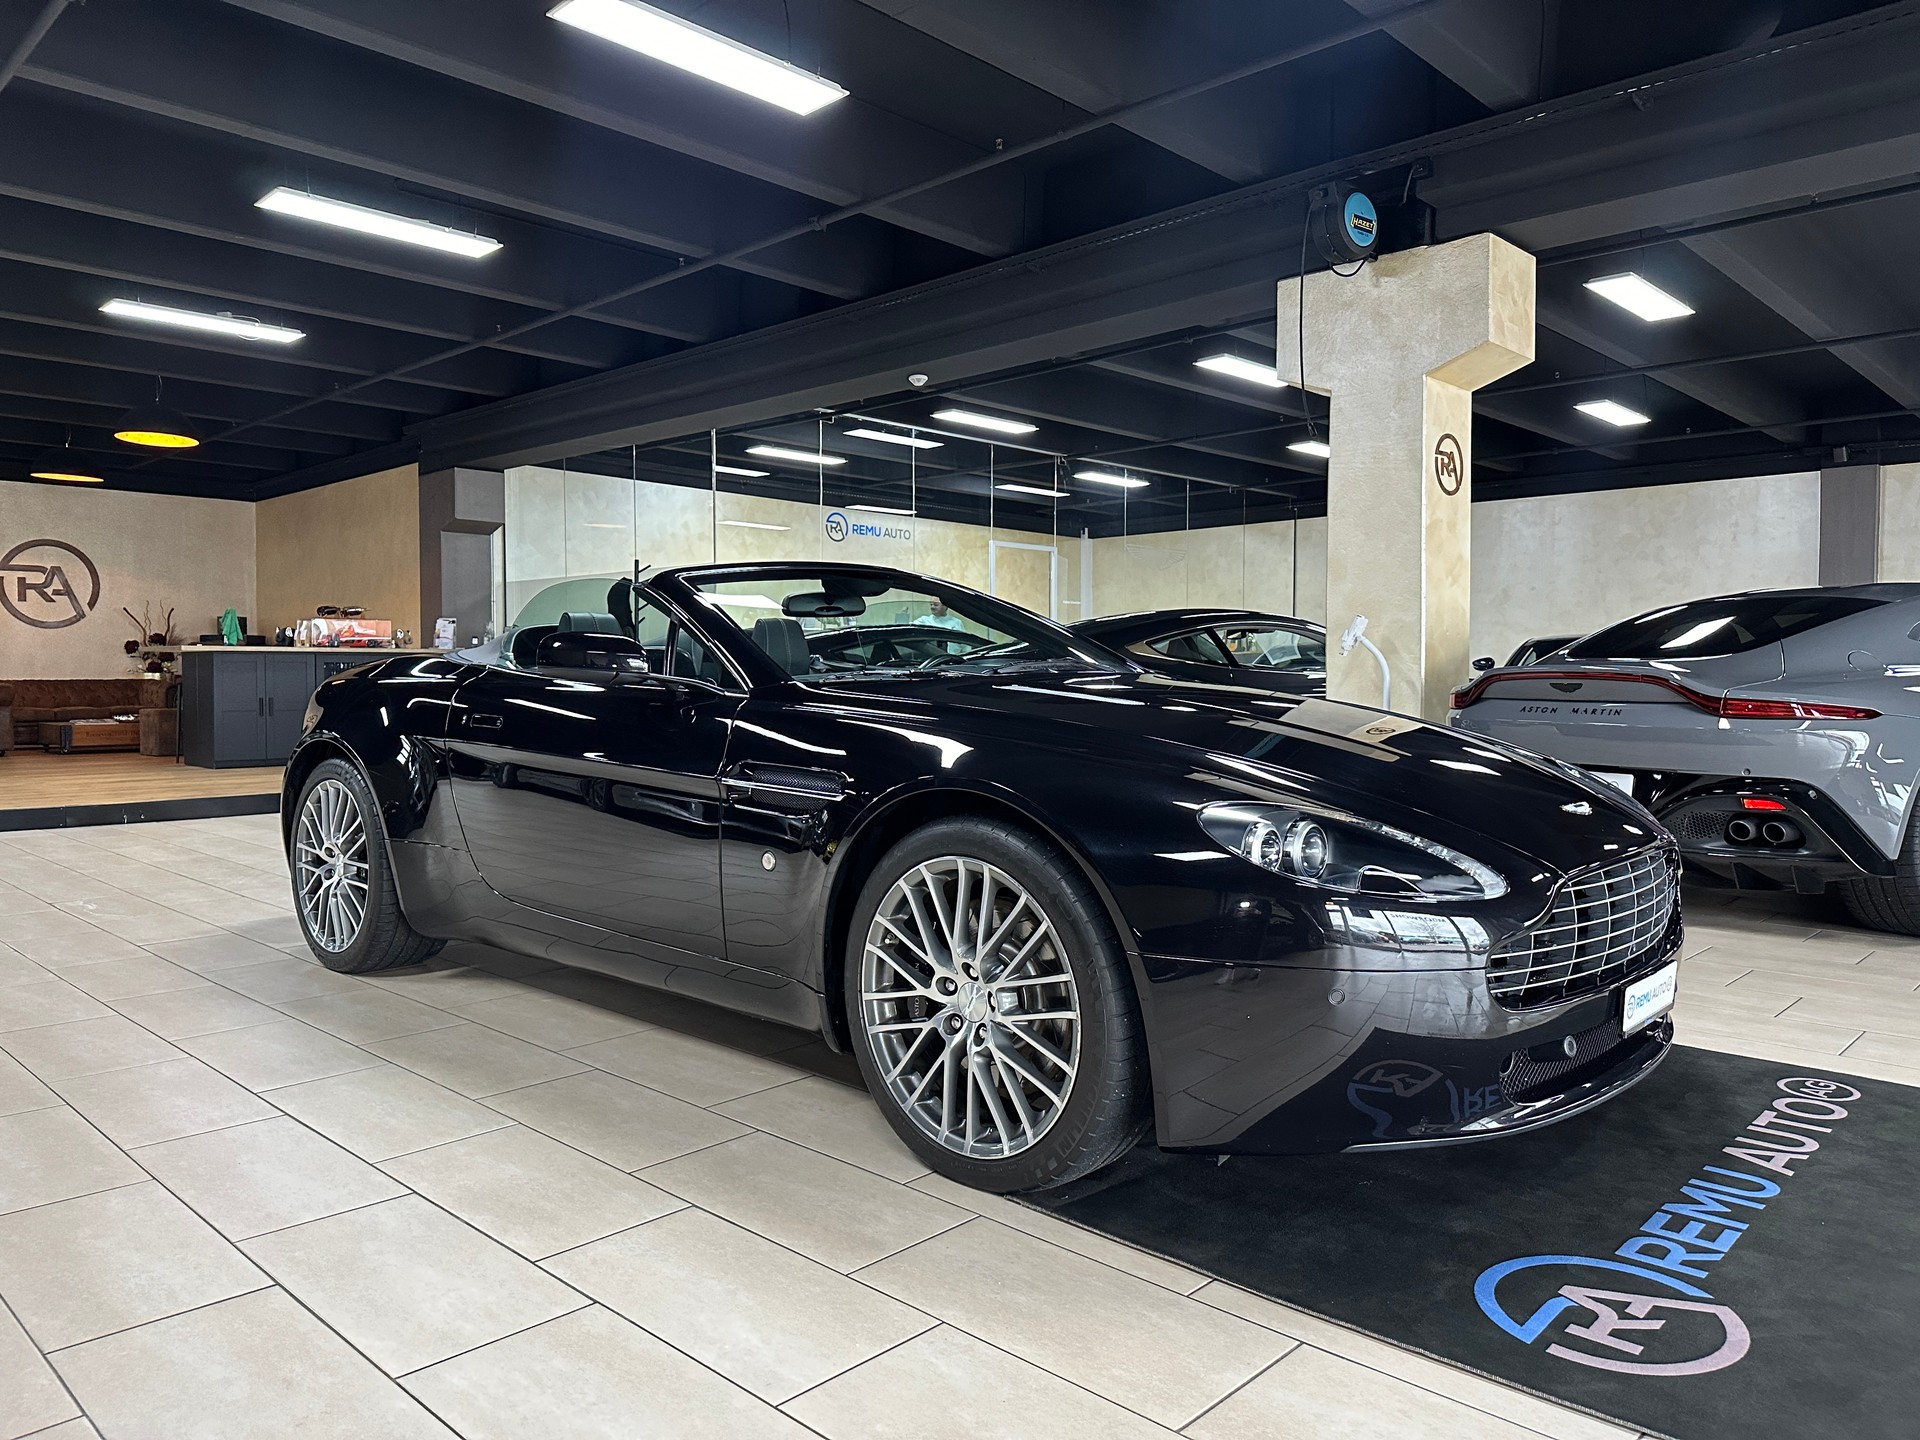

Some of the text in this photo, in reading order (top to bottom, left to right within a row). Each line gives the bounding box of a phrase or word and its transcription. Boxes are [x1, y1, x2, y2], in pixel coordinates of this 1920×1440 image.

[1353, 217, 1373, 229] HAZET
[852, 524, 882, 537] REMU
[883, 527, 911, 540] AUTO
[1520, 706, 1622, 716] ASTON MARTIN
[1615, 1165, 1781, 1278] REMU
[1722, 1097, 1849, 1176] AUTO
